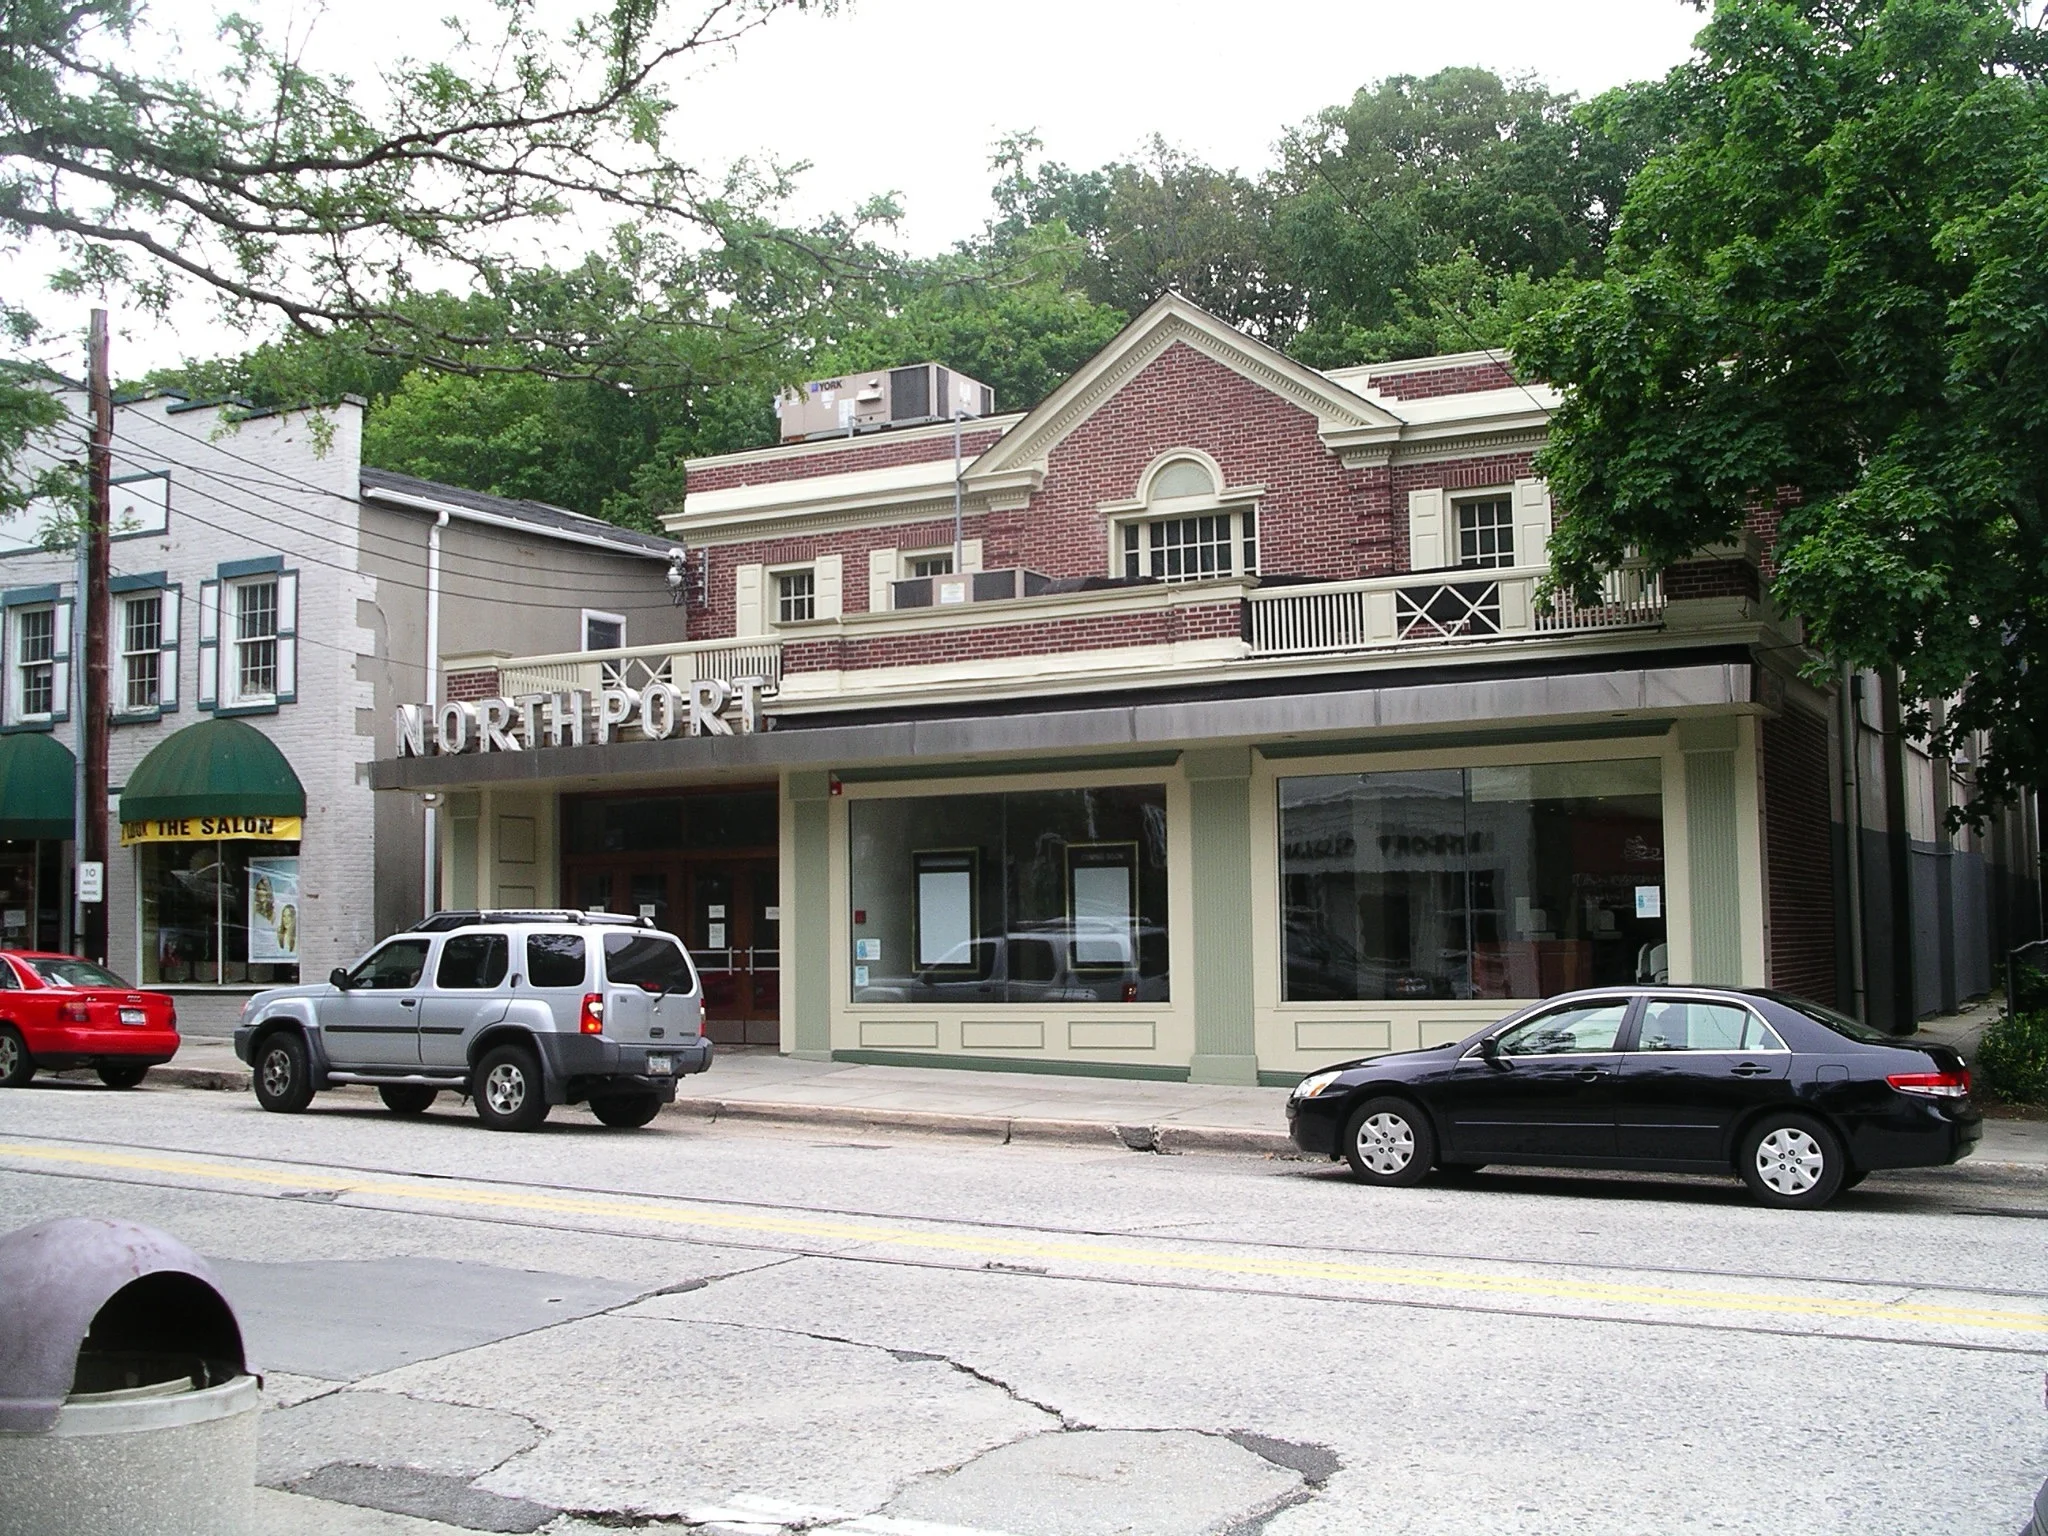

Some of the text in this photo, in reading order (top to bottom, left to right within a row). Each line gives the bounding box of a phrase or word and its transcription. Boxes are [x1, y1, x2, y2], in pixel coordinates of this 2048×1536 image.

[819, 380, 842, 391] YORK
[397, 674, 773, 758] NORTHPORT
[157, 818, 191, 836] THE
[201, 815, 275, 835] SALON
[85, 868, 96, 877] 10
